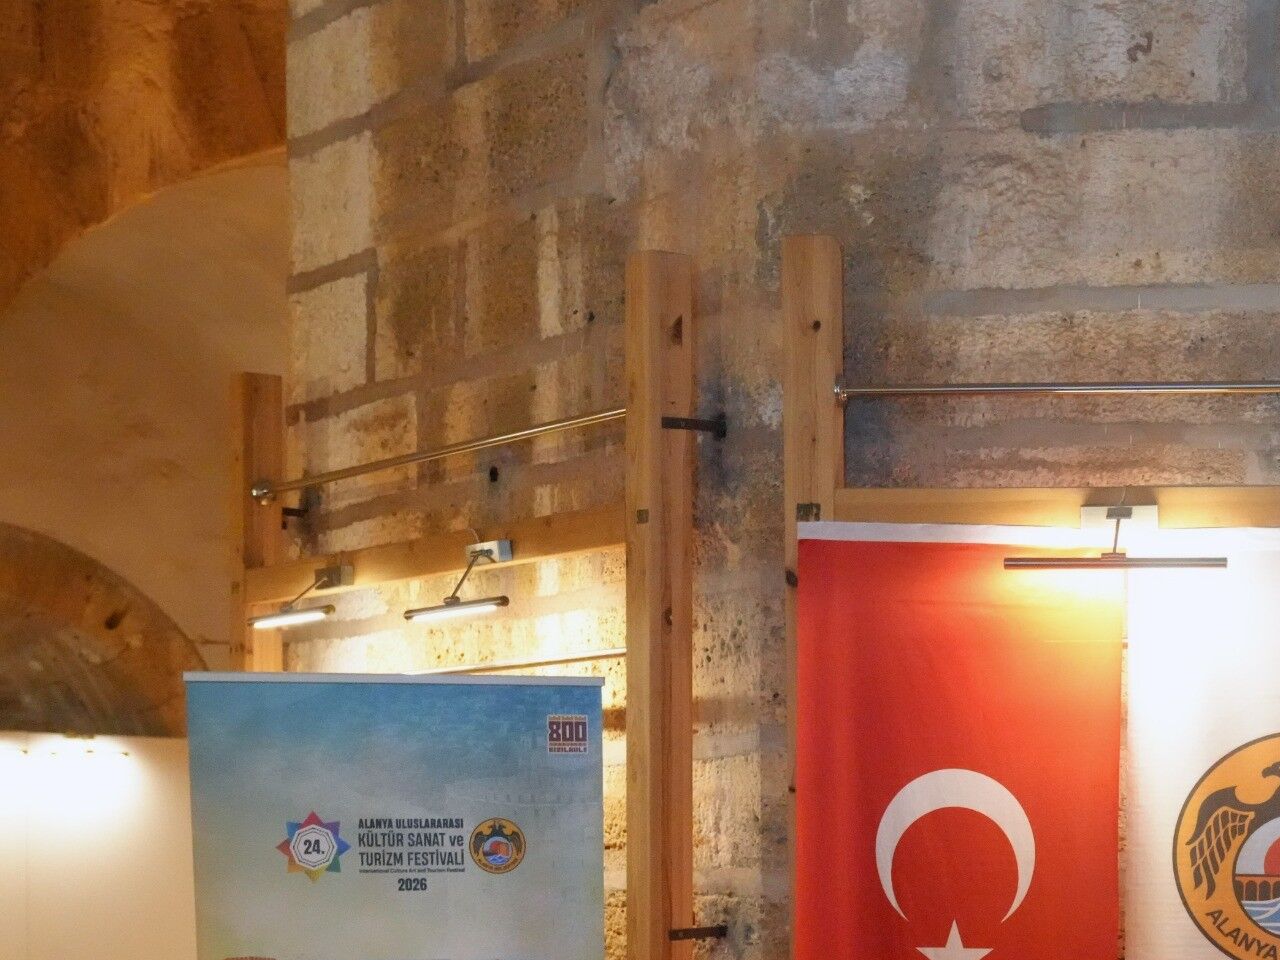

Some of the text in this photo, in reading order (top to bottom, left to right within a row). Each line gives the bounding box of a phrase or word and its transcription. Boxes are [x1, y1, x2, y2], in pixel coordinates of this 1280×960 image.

[548, 721, 587, 742] 800
[358, 817, 464, 829] ALANYA ULUSLARARASI
[358, 829, 464, 847] KÜLTÜR SANAT ve
[303, 838, 325, 856] 24.
[359, 849, 403, 866] TURİZM
[407, 849, 465, 866] FESTİVALİ
[397, 878, 427, 892] 2026
